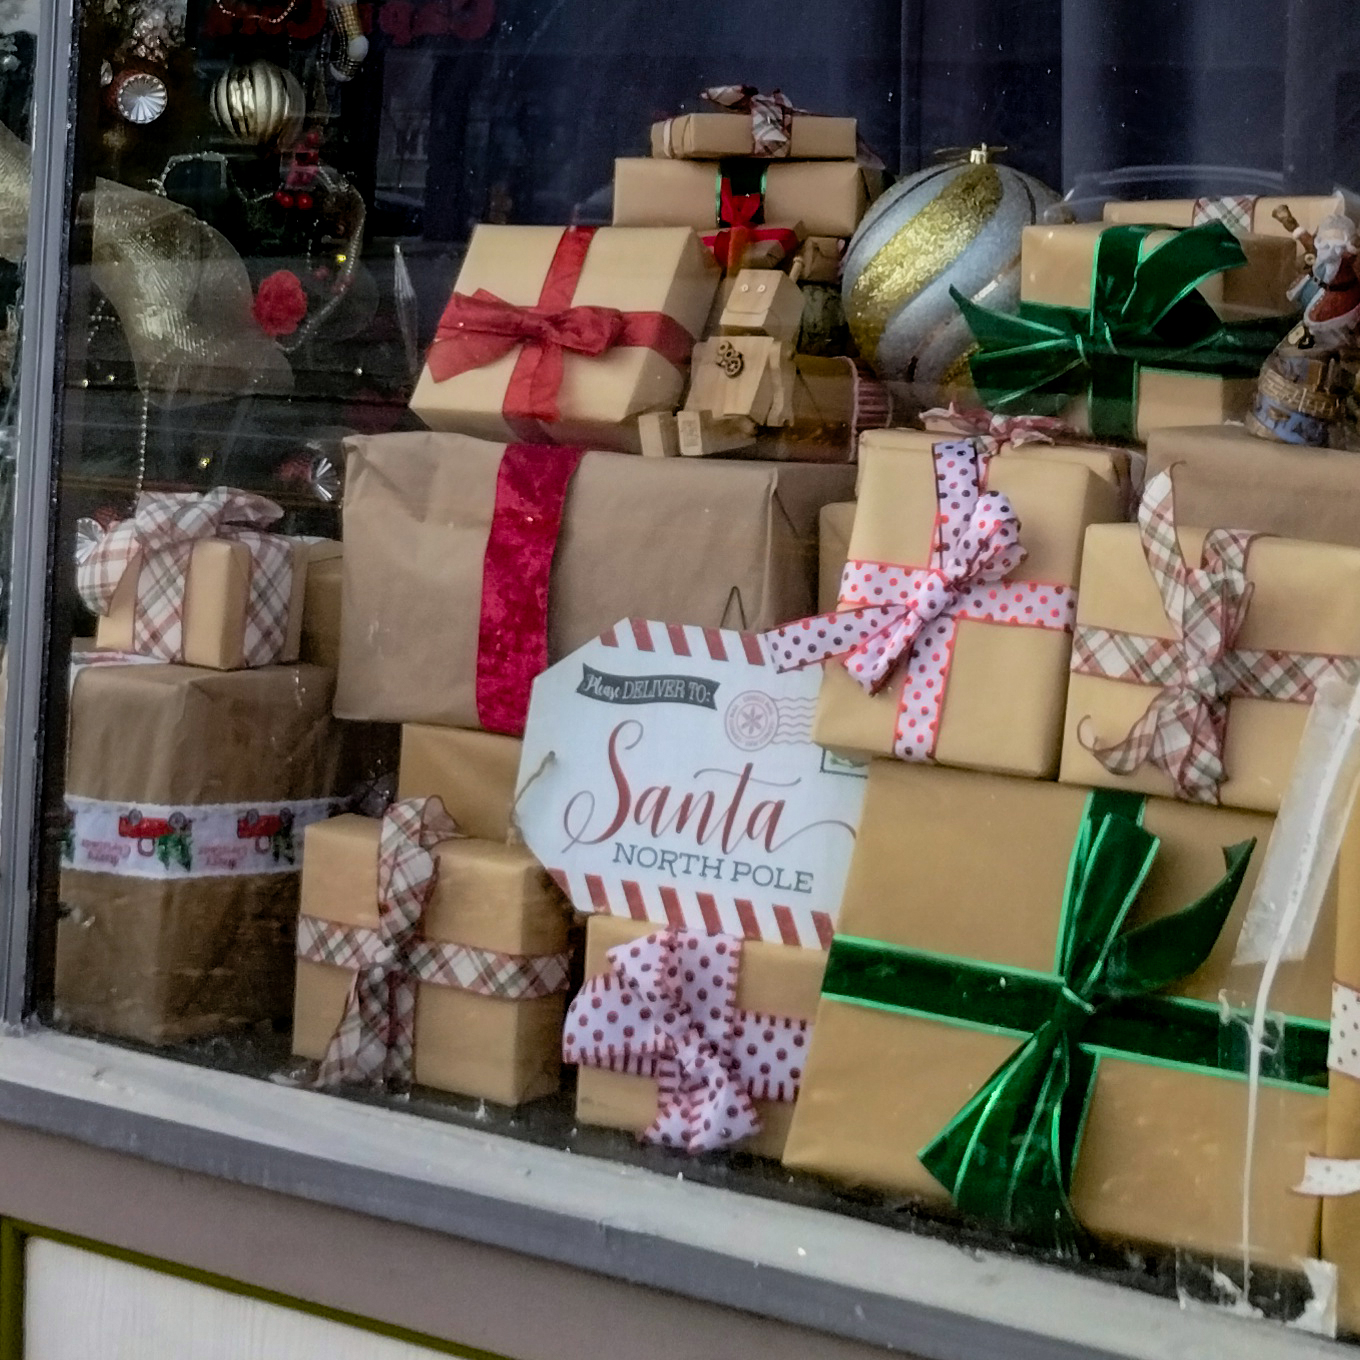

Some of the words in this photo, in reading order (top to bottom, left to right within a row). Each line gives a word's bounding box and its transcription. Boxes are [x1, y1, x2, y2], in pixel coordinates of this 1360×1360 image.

[585, 674, 621, 701] Please
[622, 679, 685, 700] DELIVER
[688, 681, 711, 703] TO:
[561, 719, 856, 855] Santa
[612, 842, 725, 879] NORTH
[730, 860, 814, 894] POLE
